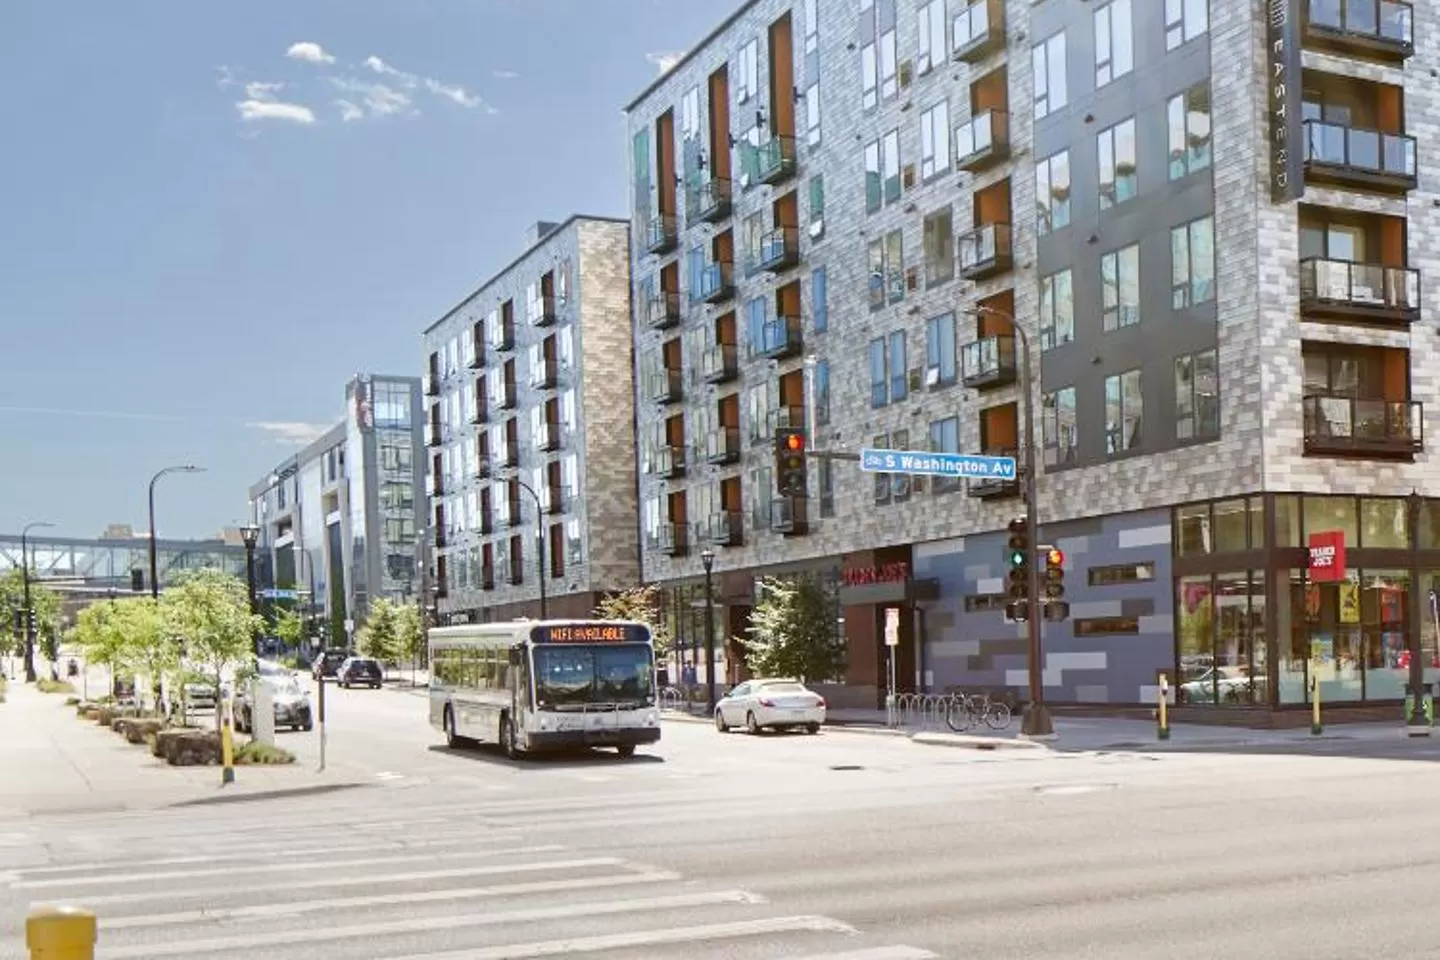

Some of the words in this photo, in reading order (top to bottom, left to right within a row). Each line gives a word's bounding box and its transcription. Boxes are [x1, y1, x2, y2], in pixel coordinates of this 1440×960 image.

[885, 455, 896, 468] S
[901, 456, 988, 473] Washington
[992, 463, 1011, 474] Av
